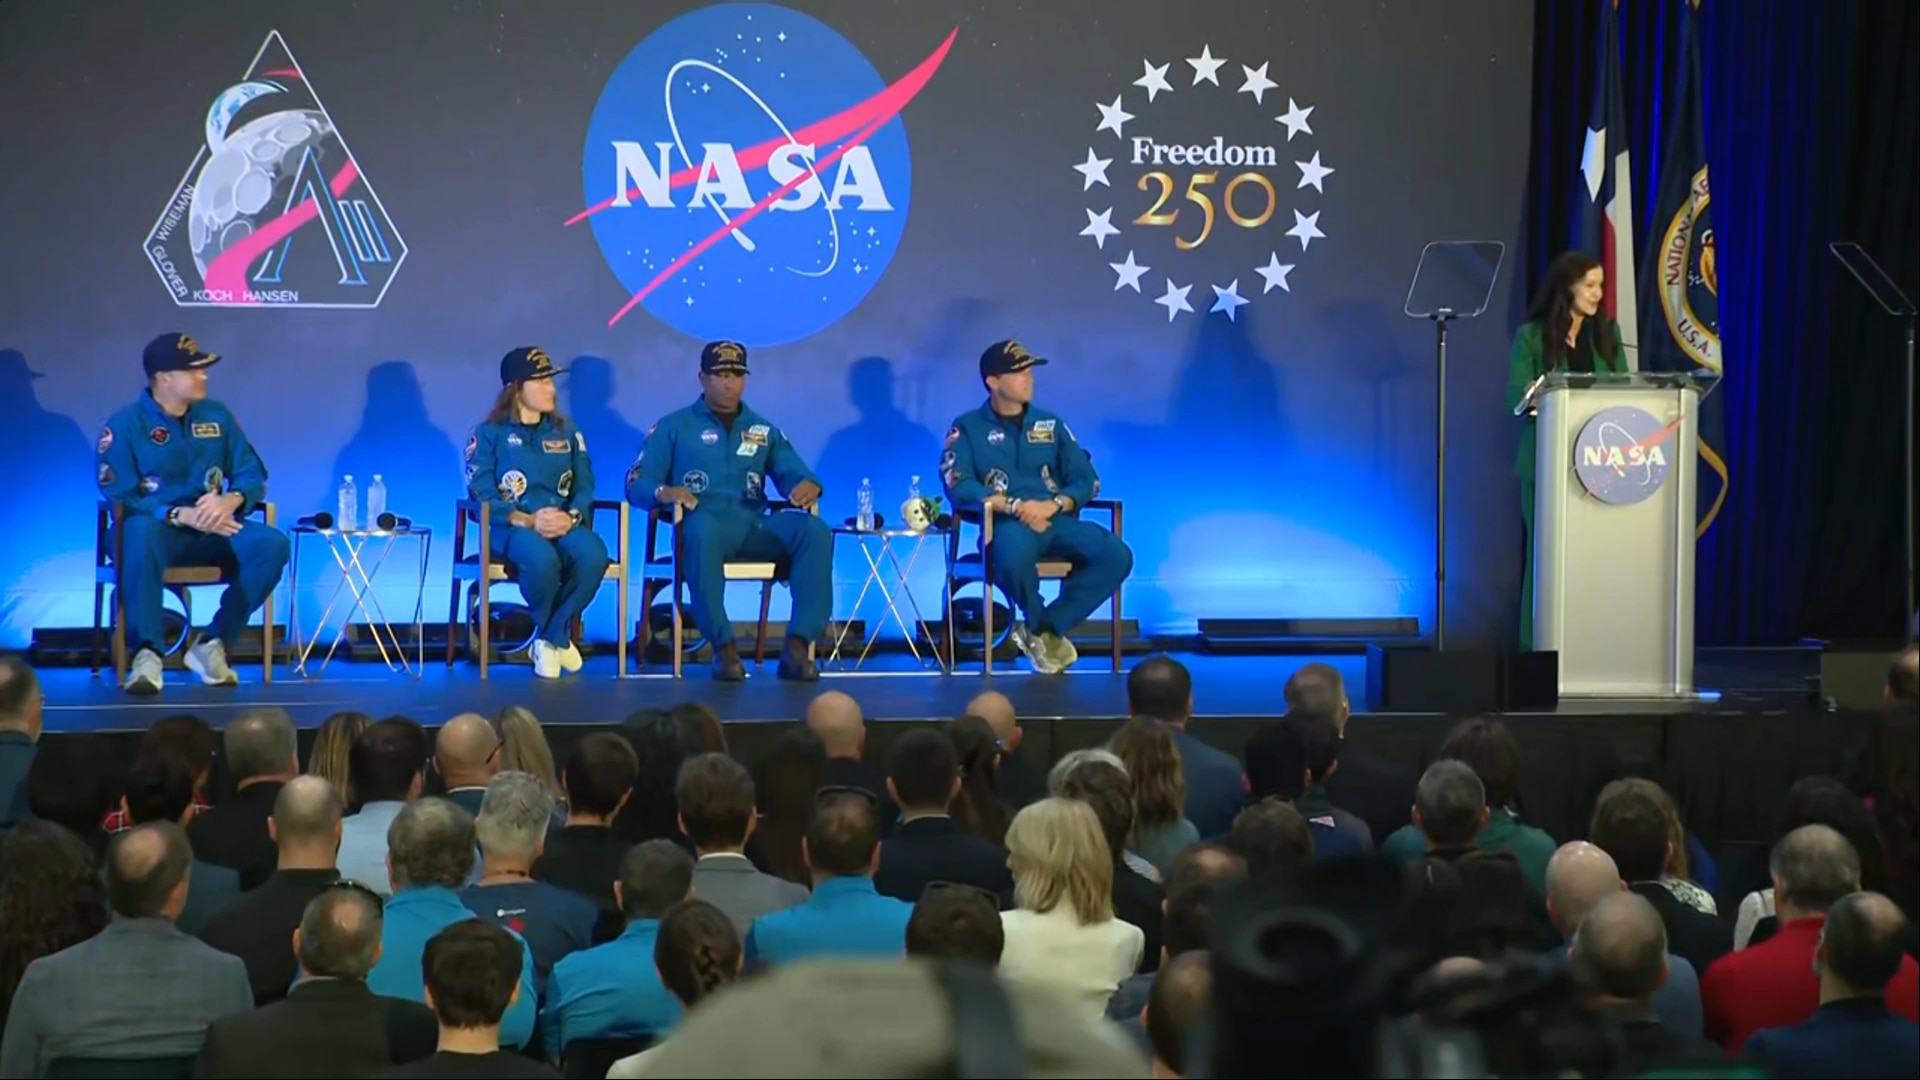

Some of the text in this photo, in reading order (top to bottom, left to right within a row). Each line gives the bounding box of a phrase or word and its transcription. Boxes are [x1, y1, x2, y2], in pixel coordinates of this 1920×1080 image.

[610, 141, 895, 211] NASA
[1131, 136, 1277, 166] Freedom
[156, 184, 195, 242] WISEMAN
[1131, 170, 1277, 250] 250
[152, 246, 188, 297] GLOVER
[1667, 207, 1694, 285] NATION
[193, 289, 299, 302] KOCH HANSEN
[1677, 318, 1711, 357] U.S.A.
[1583, 445, 1666, 467] NASA
